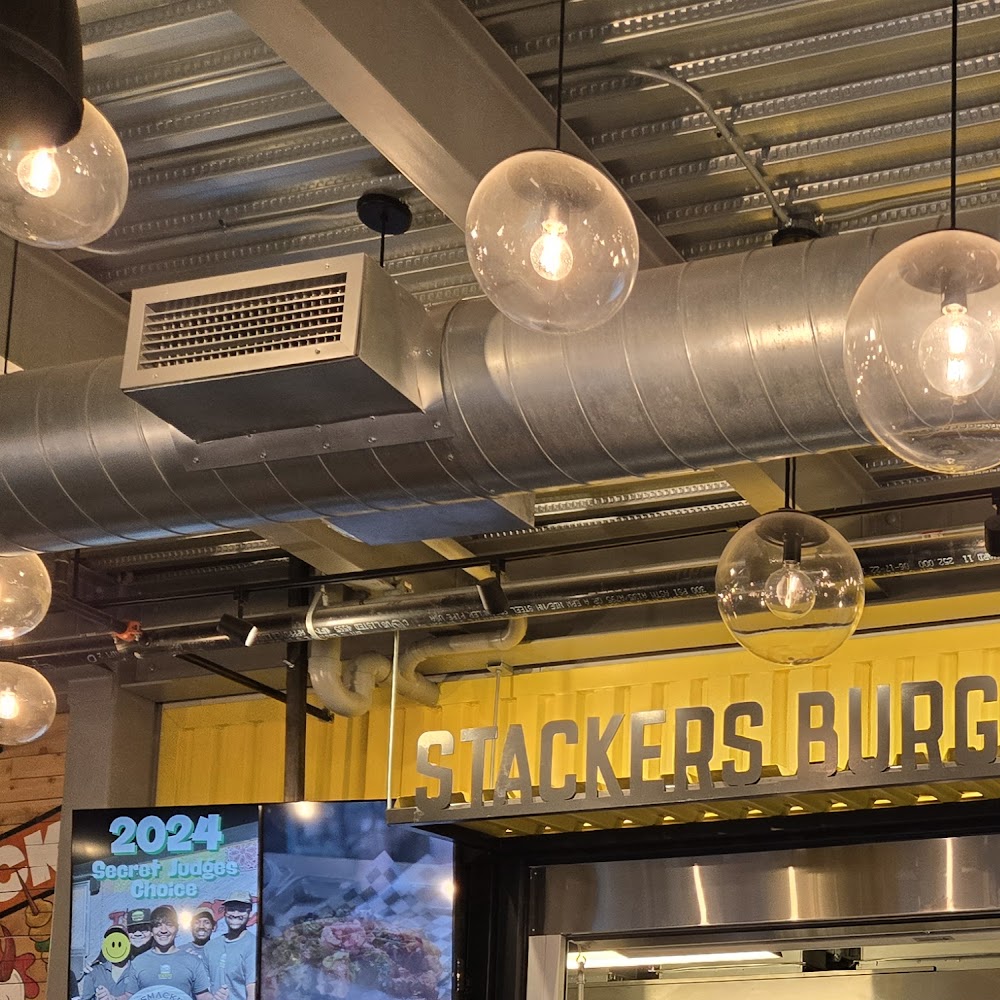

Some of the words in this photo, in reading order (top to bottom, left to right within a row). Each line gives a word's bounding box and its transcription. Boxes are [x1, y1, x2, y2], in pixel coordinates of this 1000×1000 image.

[415, 700, 764, 811] STACKERS
[109, 814, 224, 855] 2024
[92, 859, 162, 881] Secret
[170, 859, 240, 881] Judges
[130, 881, 198, 899] Choice
